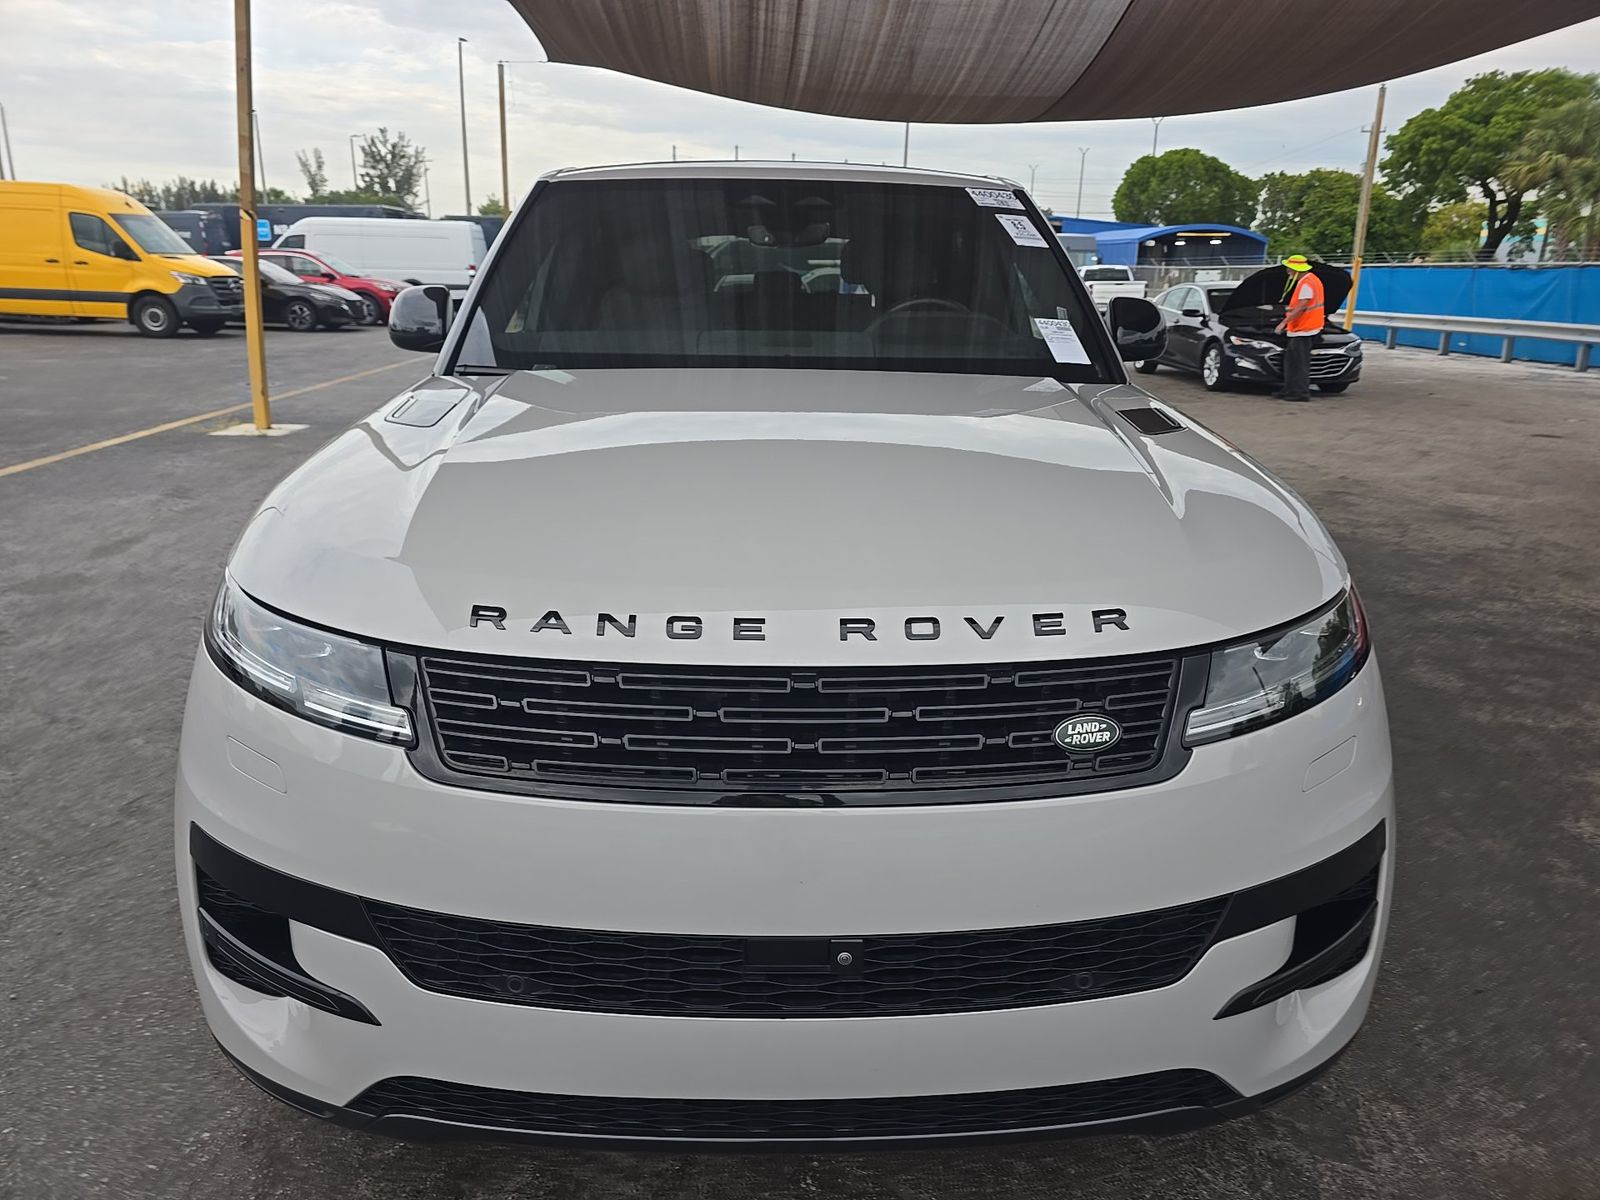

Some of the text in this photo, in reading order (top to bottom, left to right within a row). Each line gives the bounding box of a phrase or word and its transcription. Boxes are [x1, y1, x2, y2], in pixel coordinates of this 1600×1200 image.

[470, 604, 1130, 641] RANGE ROVER
[1067, 722, 1100, 735] LAND
[1071, 731, 1111, 745] ROVER
